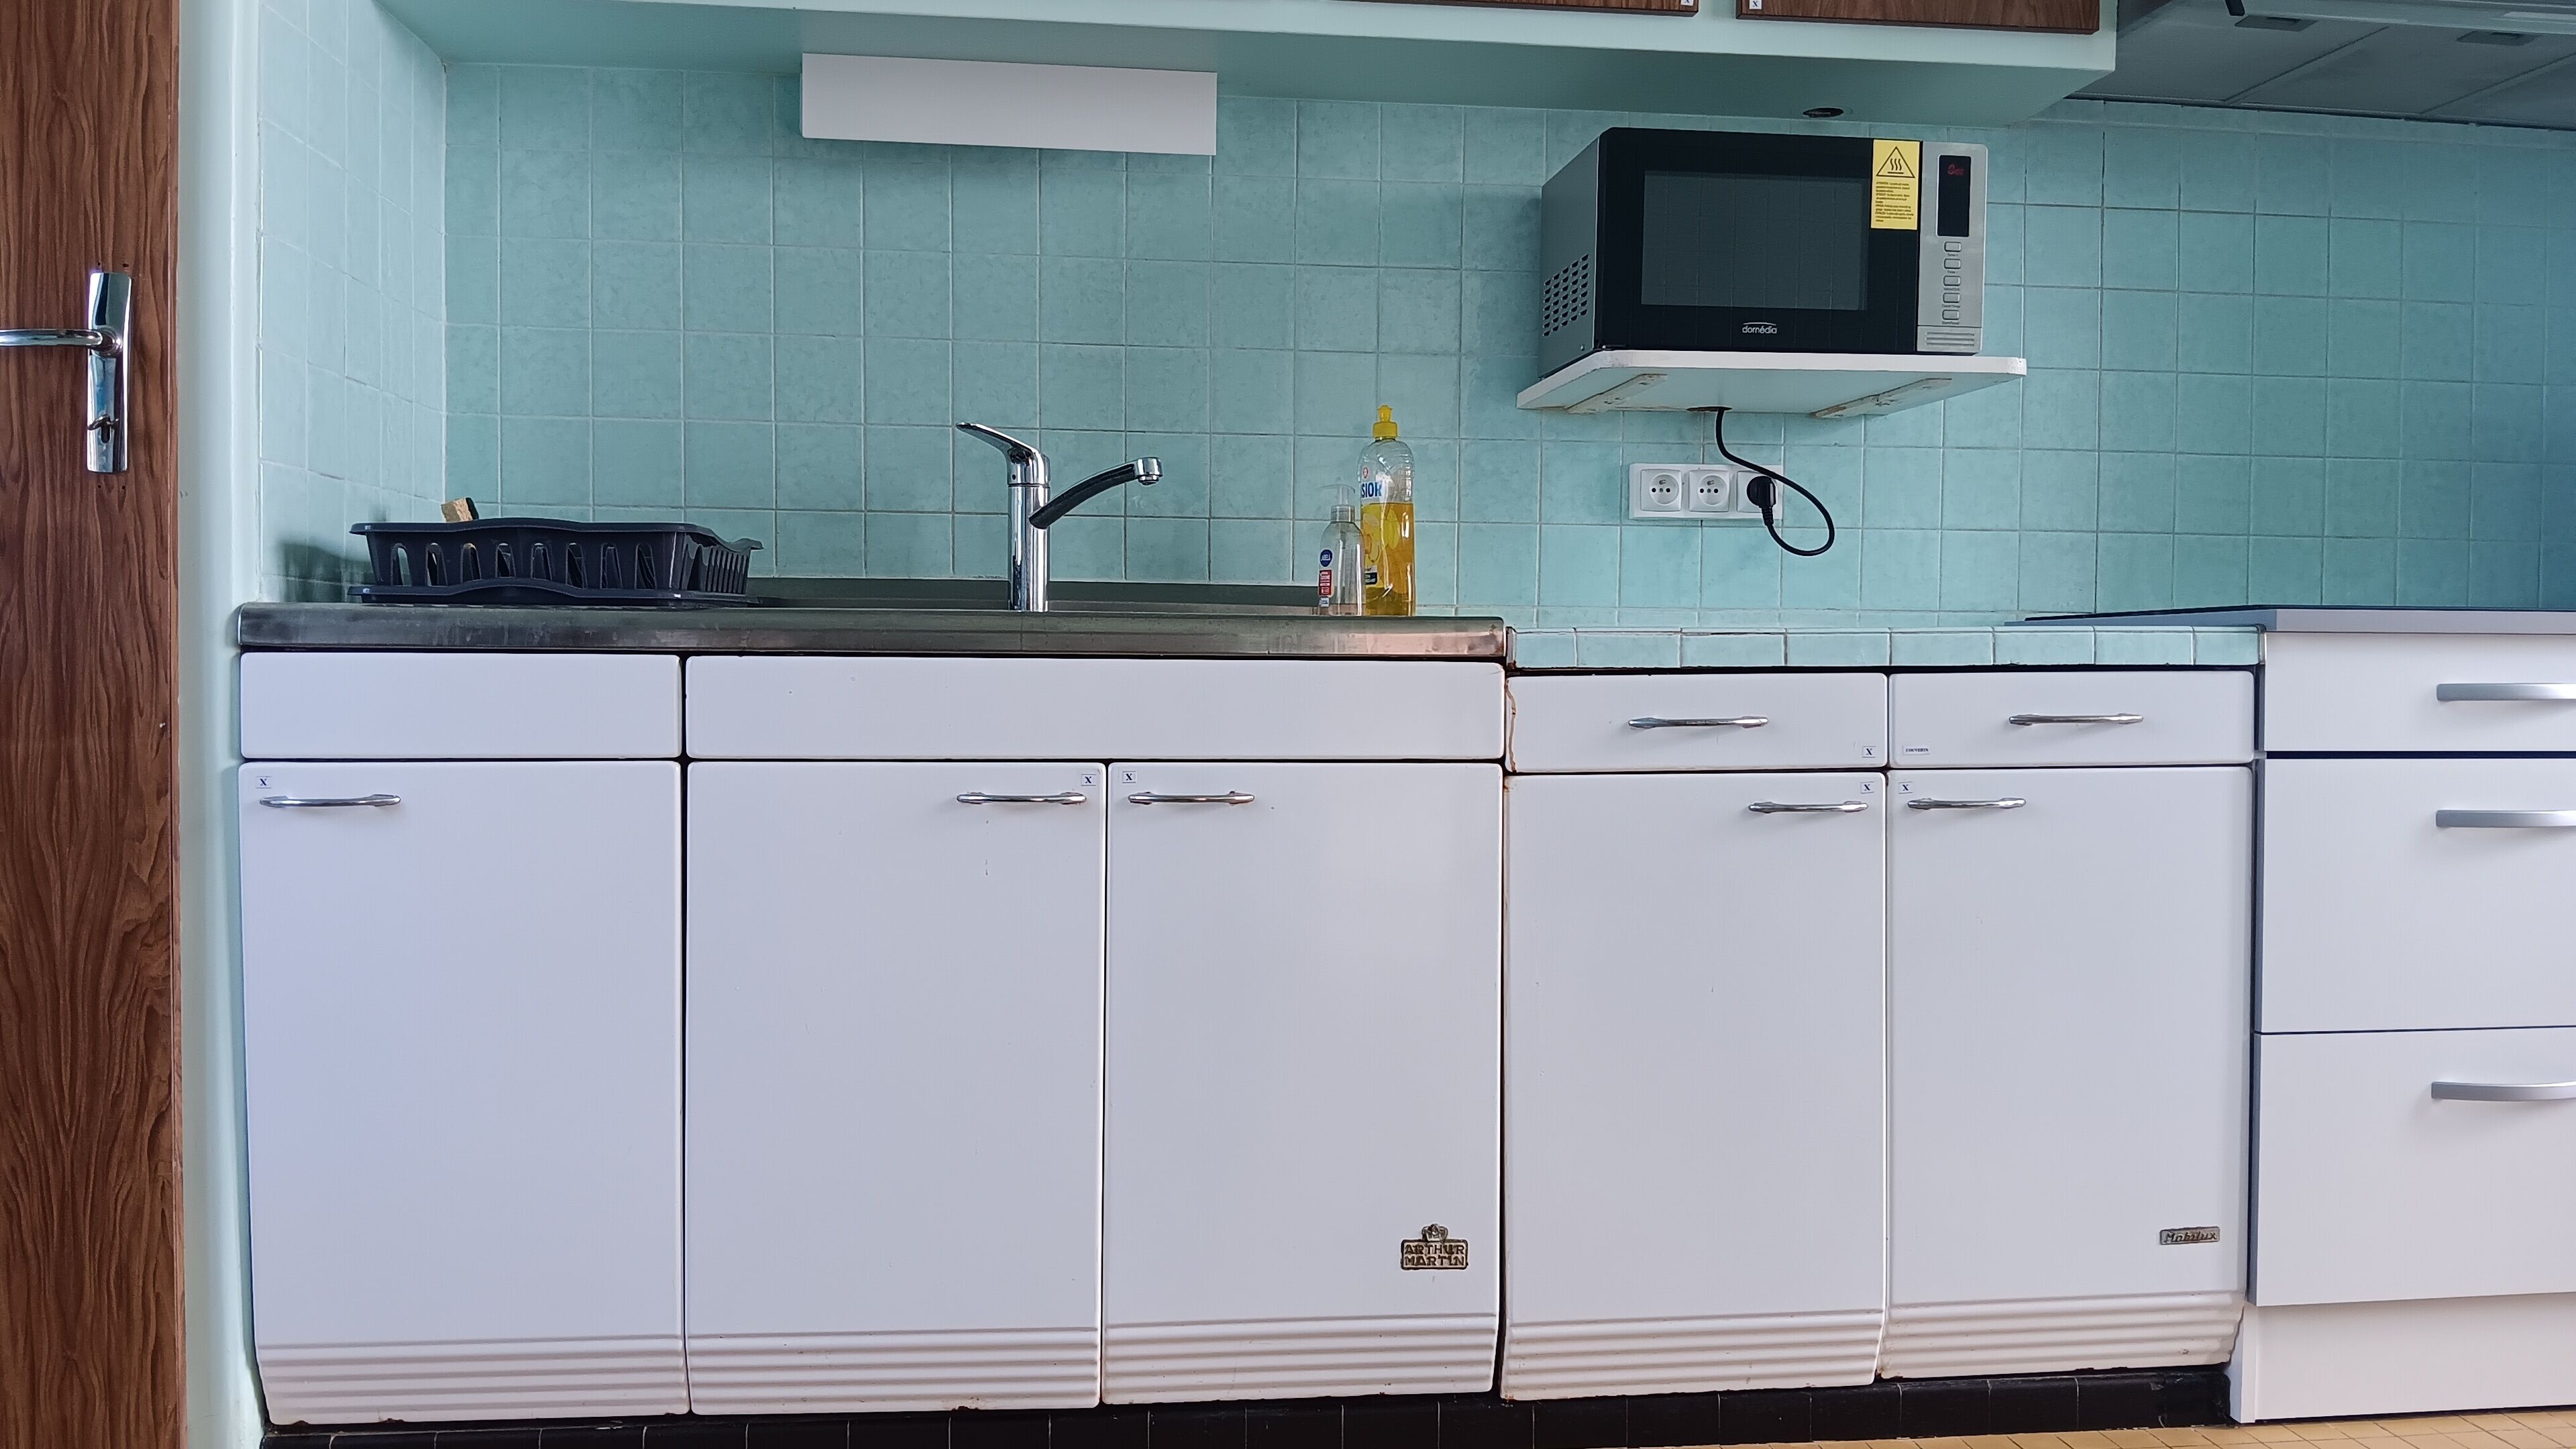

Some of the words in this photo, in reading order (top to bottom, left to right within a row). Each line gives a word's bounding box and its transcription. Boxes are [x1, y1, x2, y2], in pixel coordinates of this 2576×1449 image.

[2163, 1231, 2217, 1243] Mobilux
[1404, 1244, 1465, 1254] ARTHUR
[1404, 1255, 1464, 1266] MARTIN
